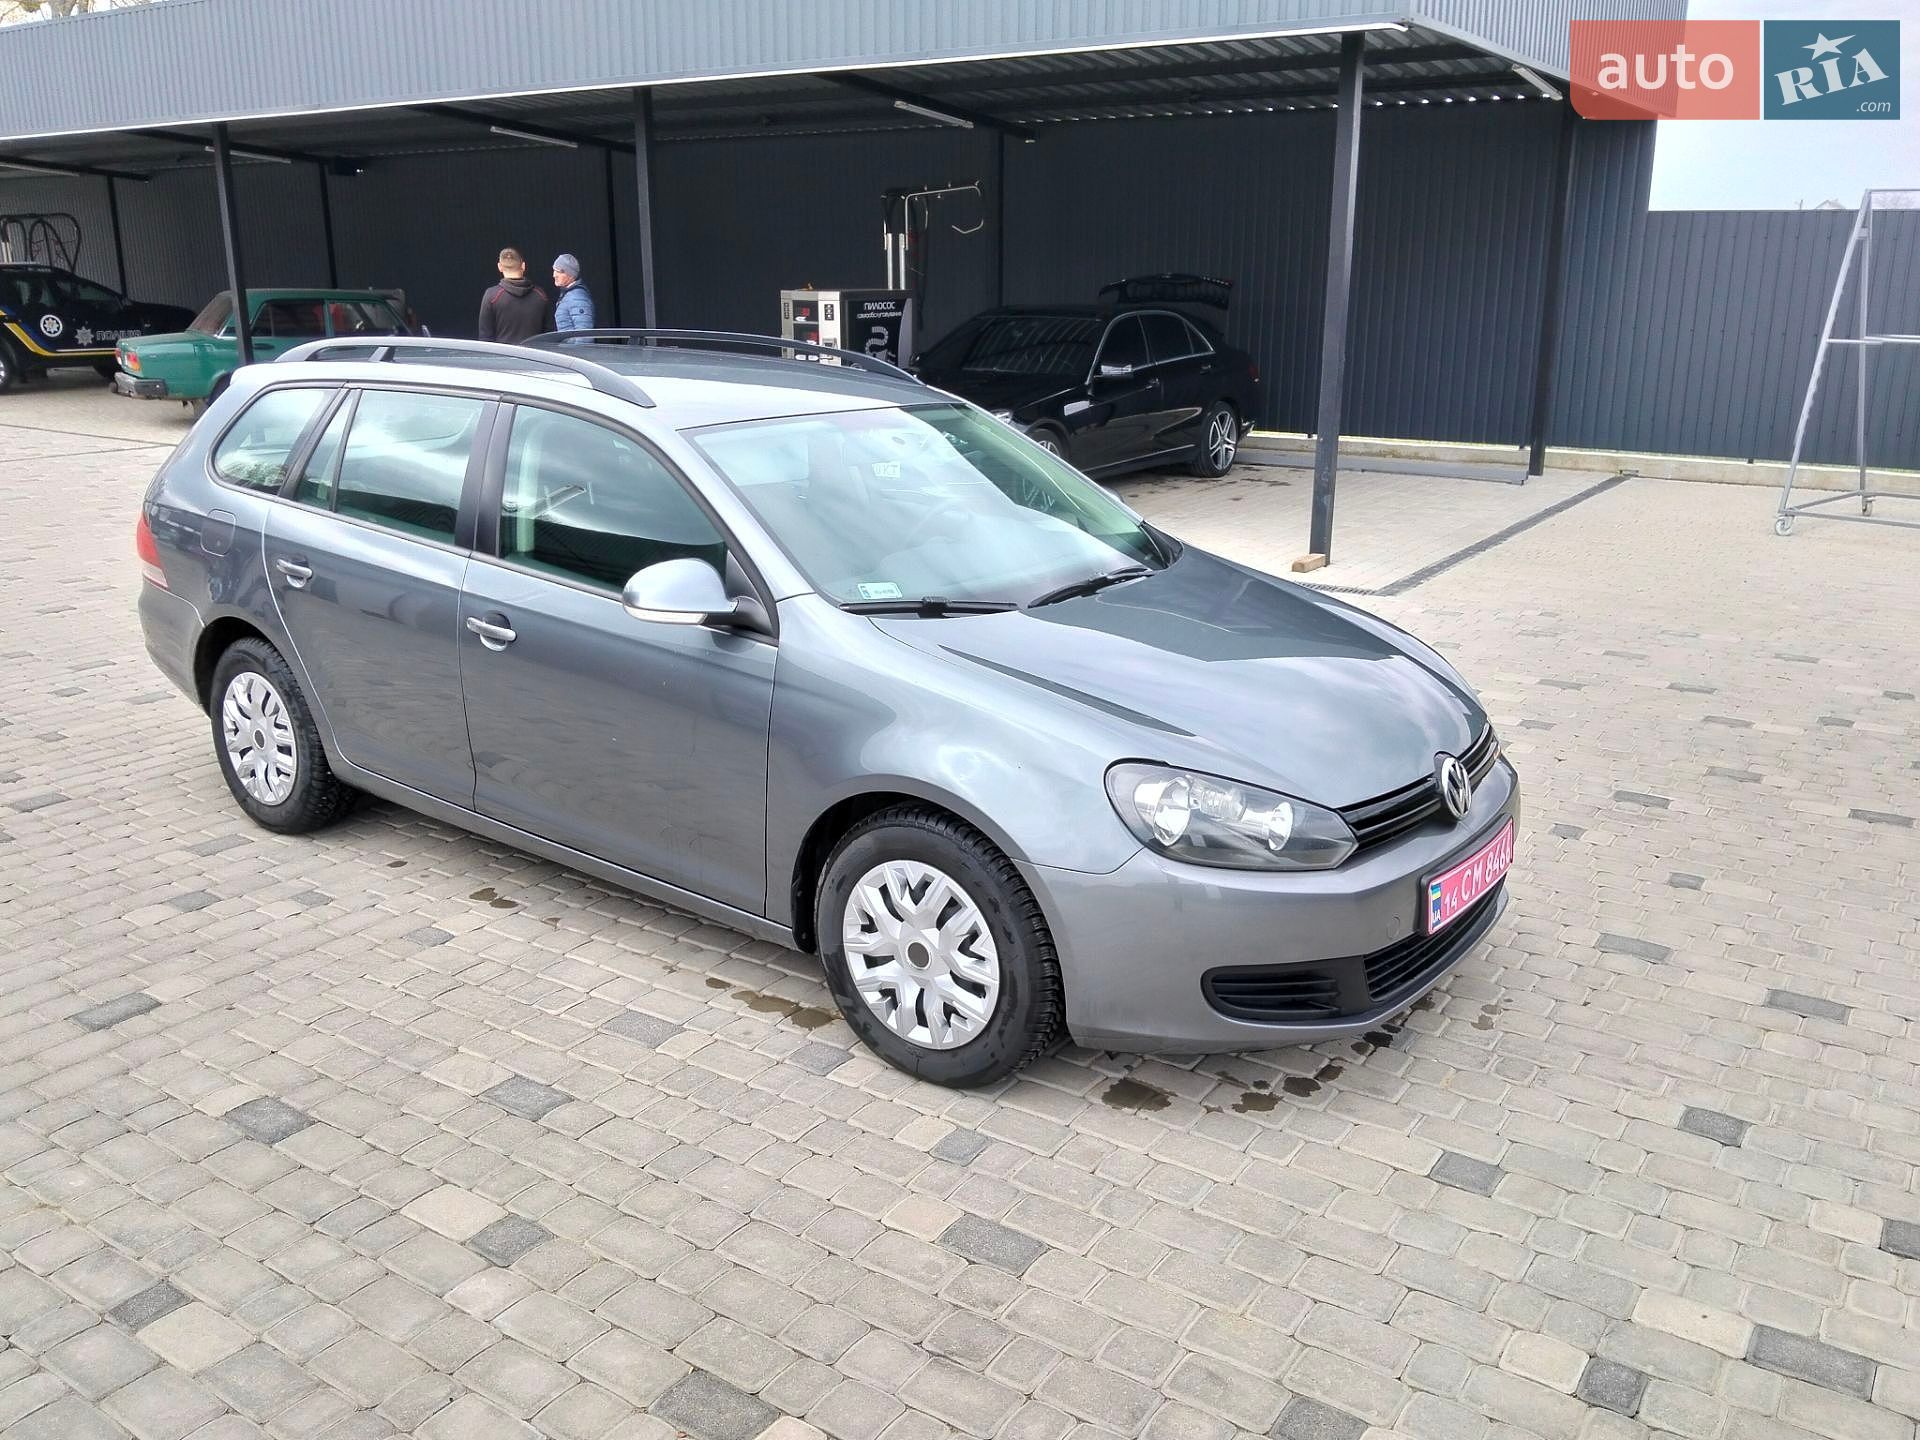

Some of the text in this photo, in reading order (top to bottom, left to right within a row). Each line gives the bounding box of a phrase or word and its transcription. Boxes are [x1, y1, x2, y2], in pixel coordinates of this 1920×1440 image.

[863, 301, 896, 311] ПИЛОСОС
[1444, 886, 1459, 916] 14
[1461, 863, 1483, 902] CM
